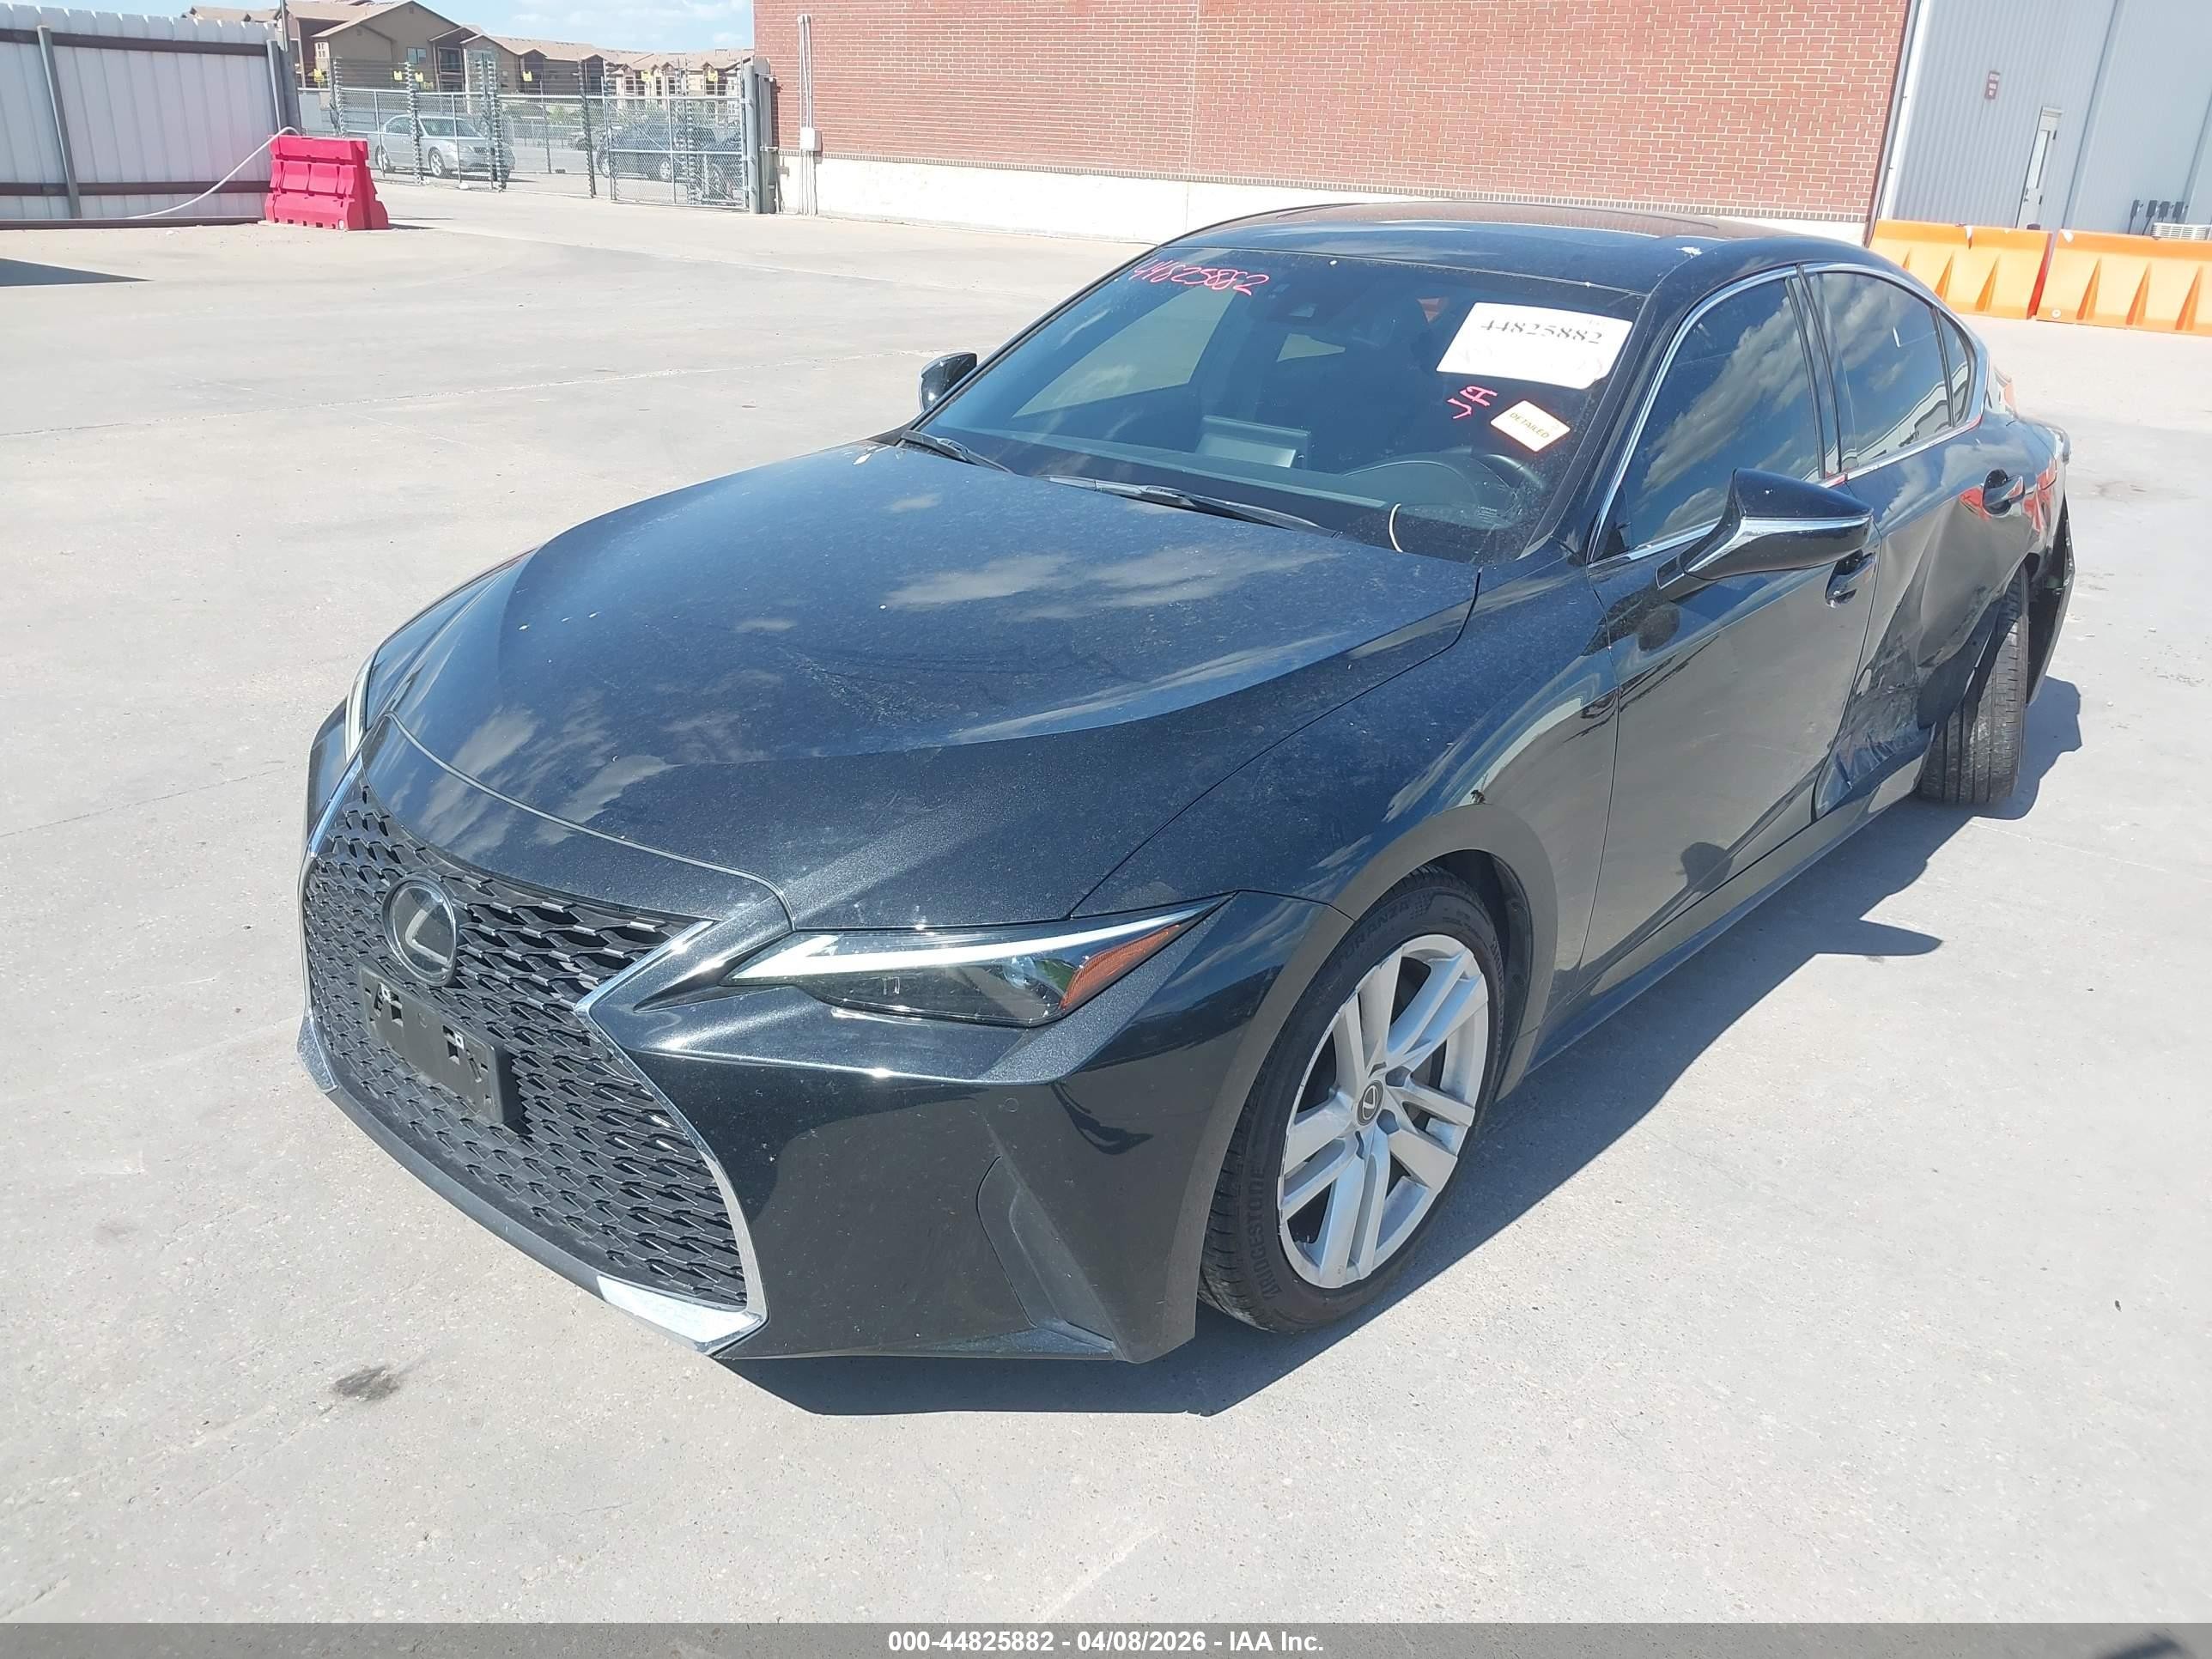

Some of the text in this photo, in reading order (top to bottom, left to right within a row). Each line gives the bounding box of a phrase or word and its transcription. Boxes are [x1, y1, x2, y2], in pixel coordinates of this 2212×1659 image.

[1128, 259, 1270, 295] 44825882
[1480, 319, 1602, 344] 44825882
[1509, 411, 1551, 439] DETAILED
